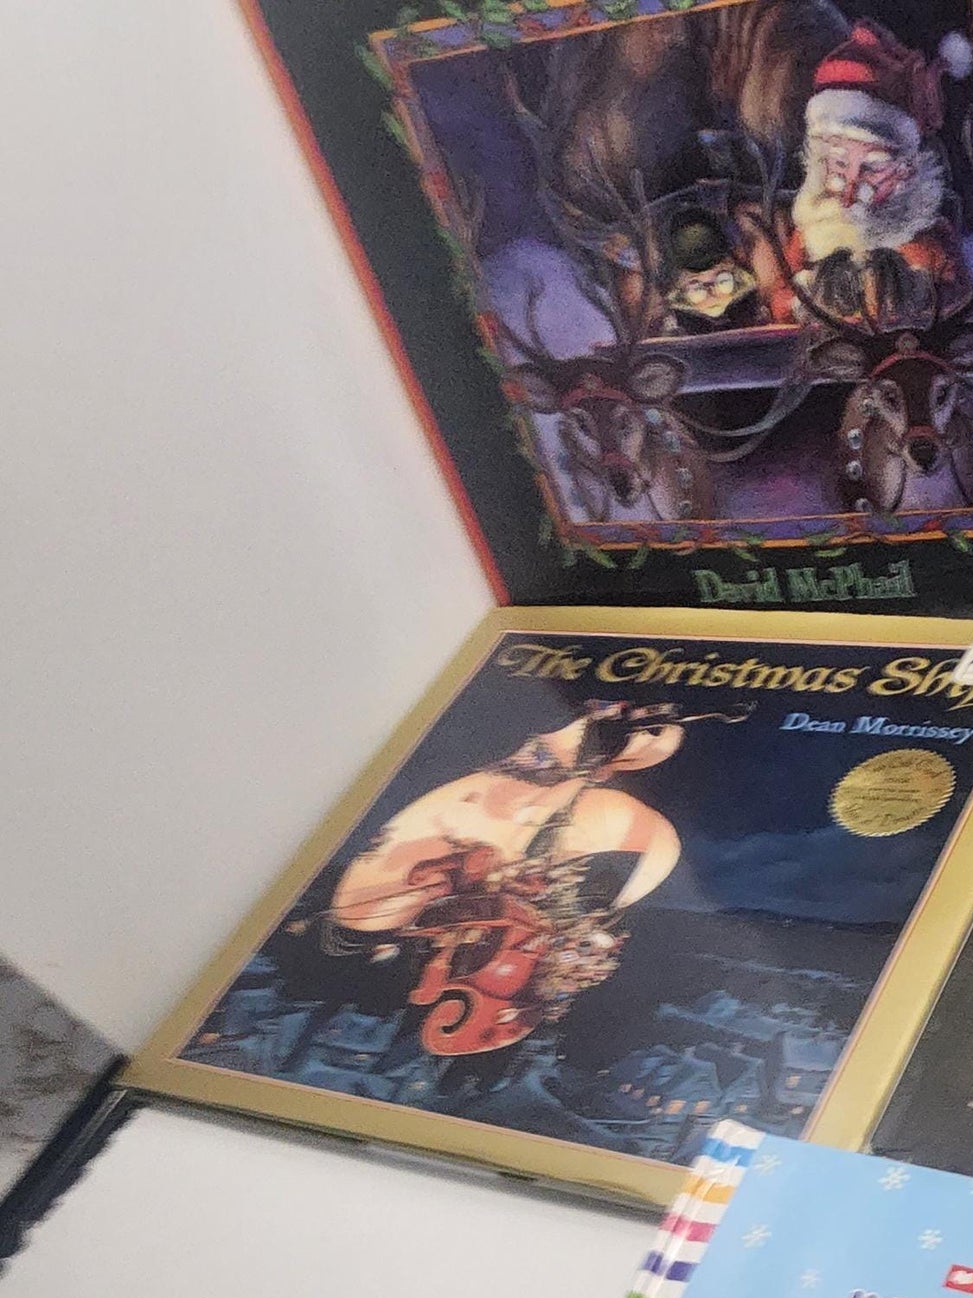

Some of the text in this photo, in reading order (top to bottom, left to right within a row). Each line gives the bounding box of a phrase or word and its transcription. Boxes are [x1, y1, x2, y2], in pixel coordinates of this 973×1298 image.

[692, 559, 917, 603] David McPhail
[499, 642, 591, 682] The
[596, 647, 862, 695] Christmas
[779, 711, 847, 734] Dean
